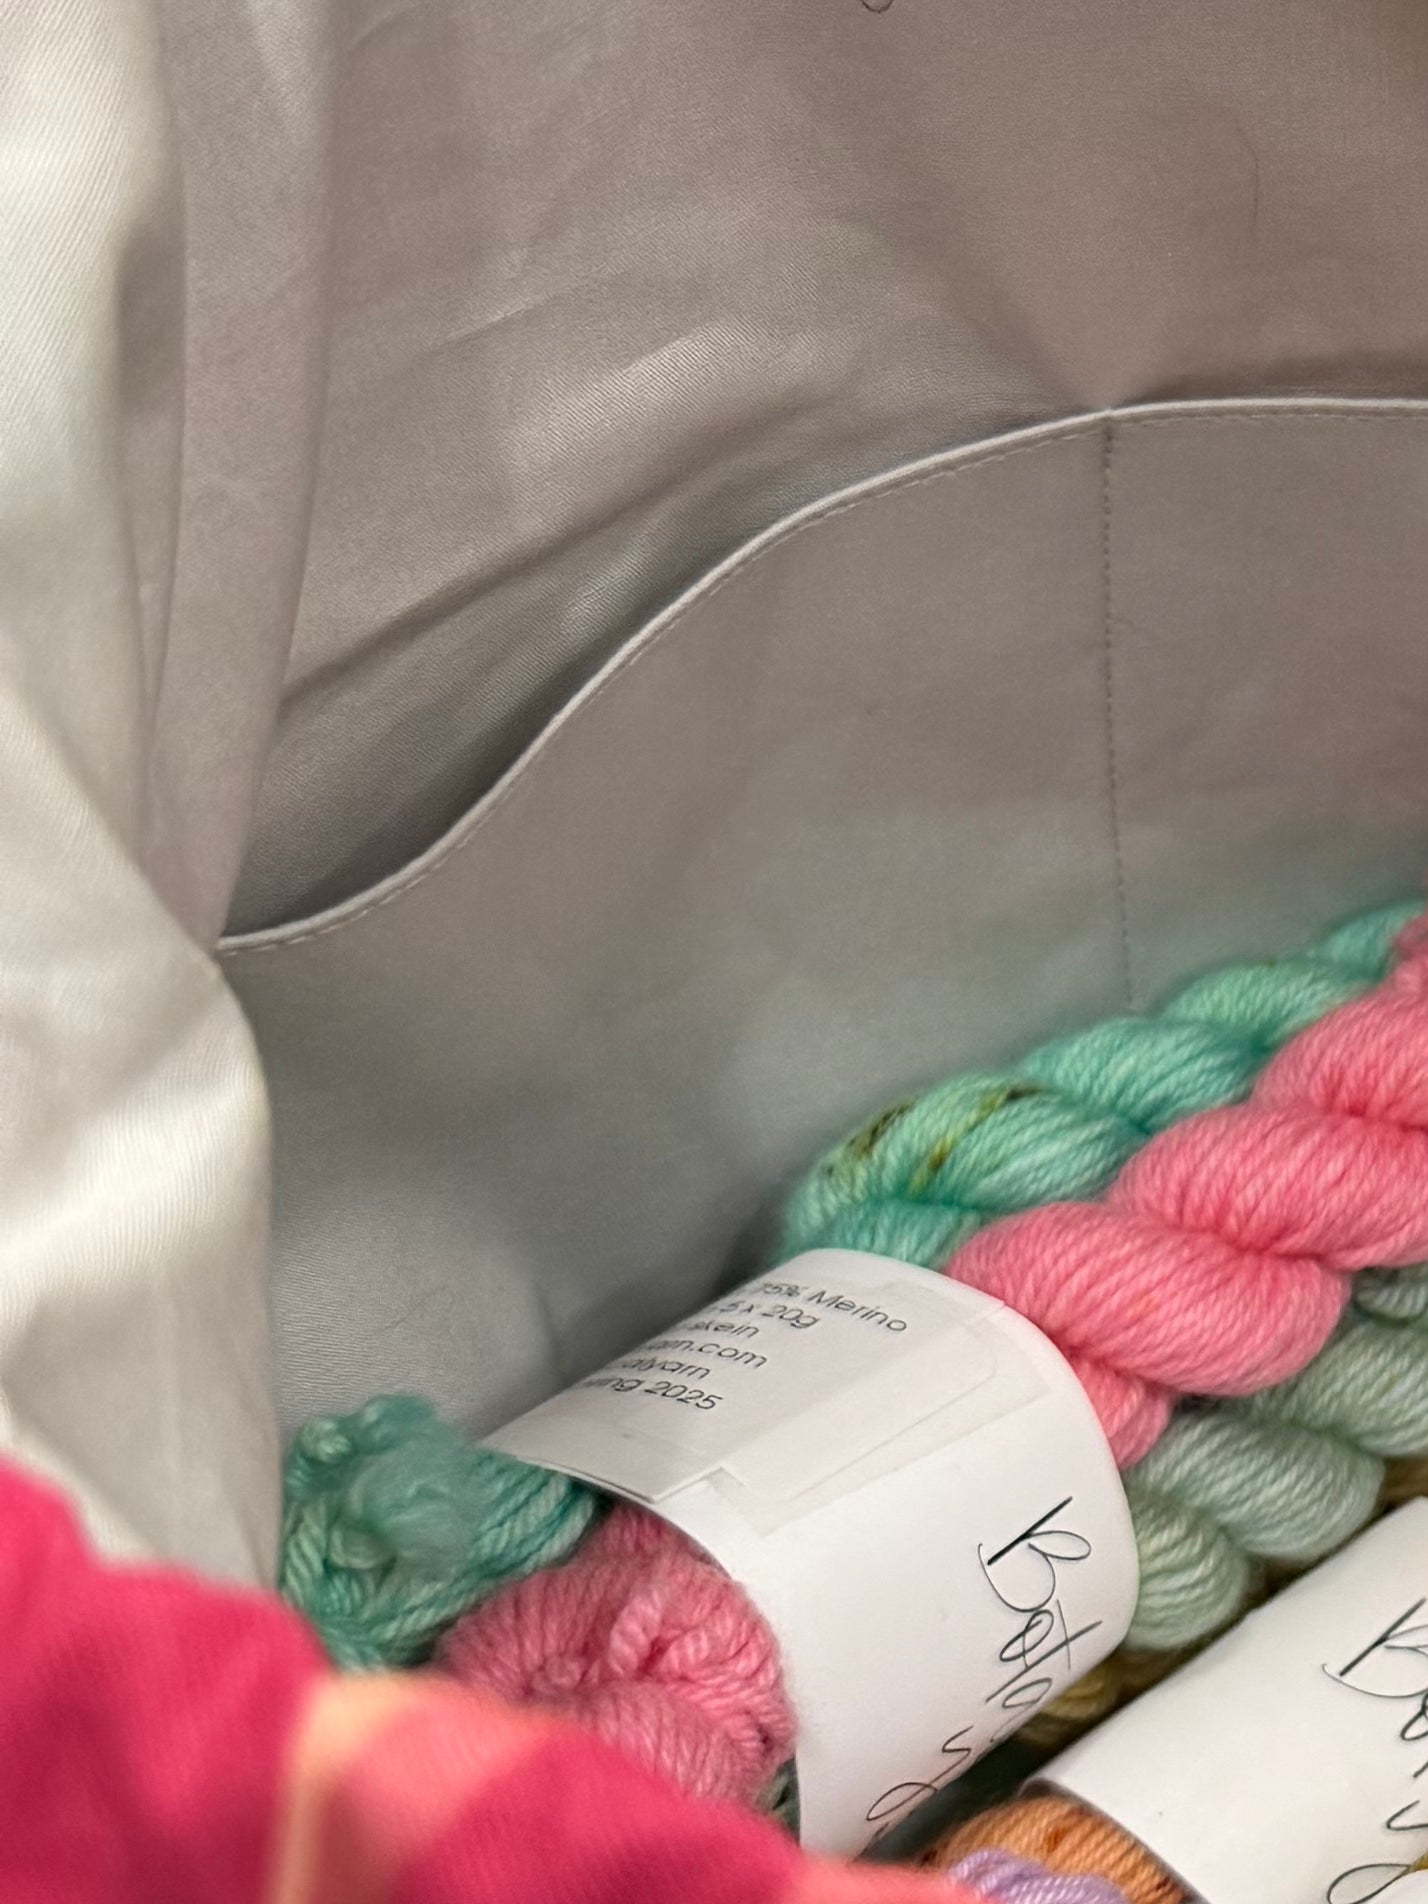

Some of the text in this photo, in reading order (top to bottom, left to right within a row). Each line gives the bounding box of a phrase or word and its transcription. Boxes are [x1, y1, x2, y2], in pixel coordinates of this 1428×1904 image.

[761, 1303, 821, 1329] 20g
[808, 1289, 907, 1332] Merino
[643, 1380, 724, 1411] 2025
